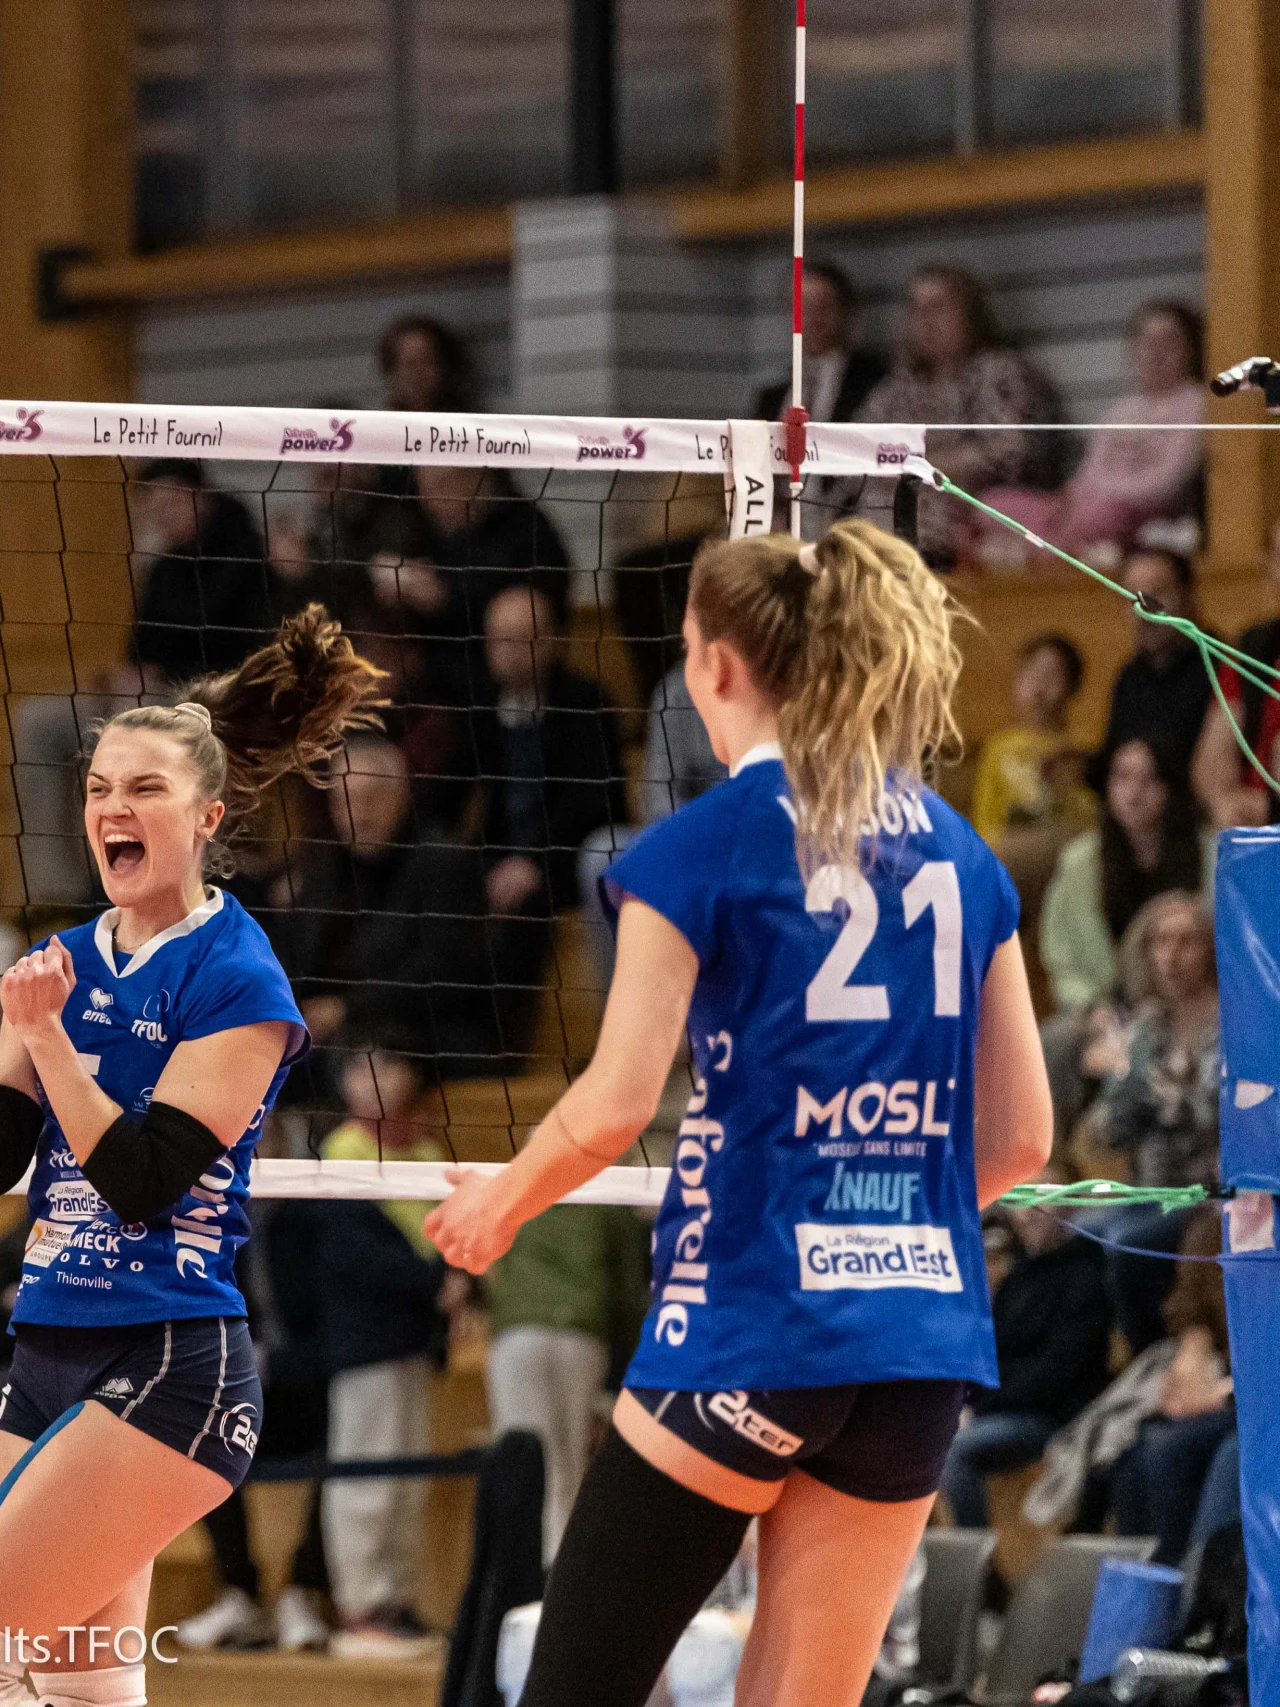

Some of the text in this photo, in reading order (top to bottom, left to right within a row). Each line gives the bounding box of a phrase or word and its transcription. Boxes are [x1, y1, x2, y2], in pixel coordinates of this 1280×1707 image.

[93, 417, 223, 447] Le Petit Fournil
[404, 426, 531, 455] Le Petit Fournil
[695, 434, 713, 460] Le
[805, 863, 963, 1022] 21
[826, 1234, 841, 1247] La
[56, 1271, 113, 1290] Thionville
